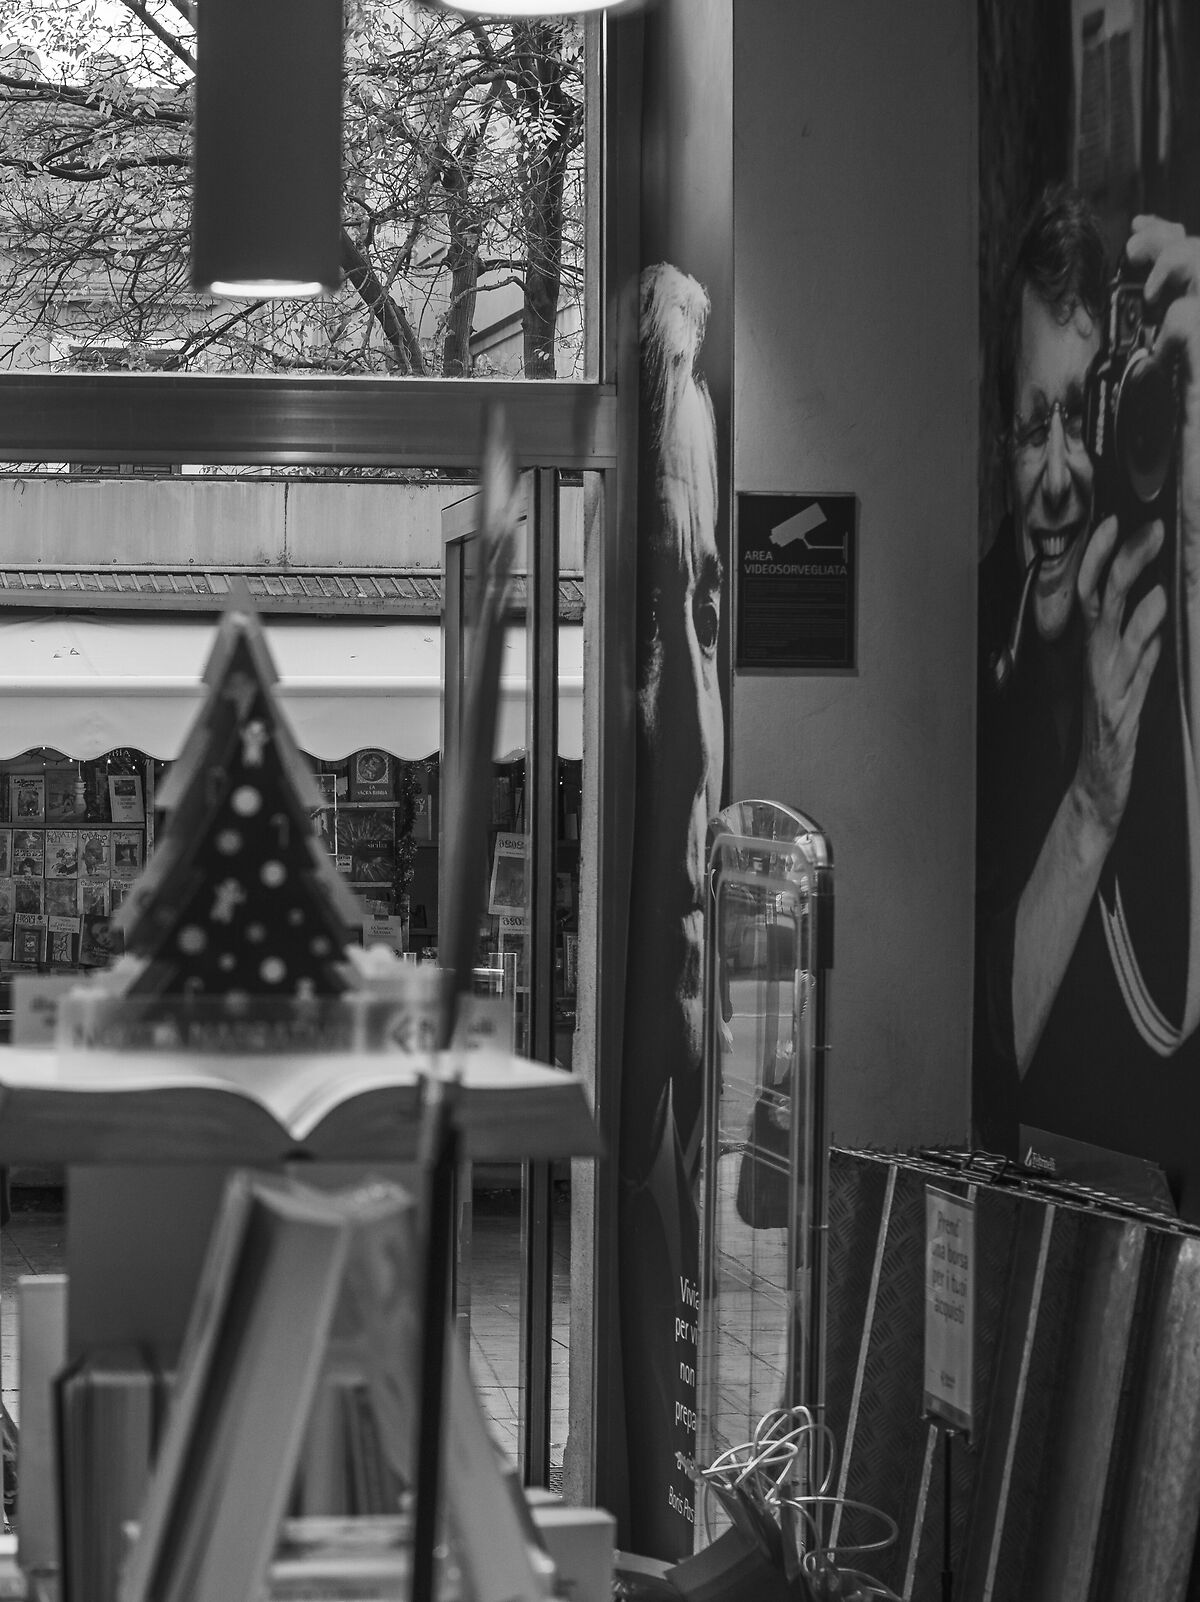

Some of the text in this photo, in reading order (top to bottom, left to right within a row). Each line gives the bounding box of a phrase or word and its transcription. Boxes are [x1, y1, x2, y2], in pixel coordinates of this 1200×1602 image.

[744, 550, 773, 561] AREA
[744, 564, 847, 576] VIDEOSORVEGLIATA
[675, 1317, 689, 1342] per
[679, 1361, 695, 1387] non
[668, 1484, 683, 1514] Boris
